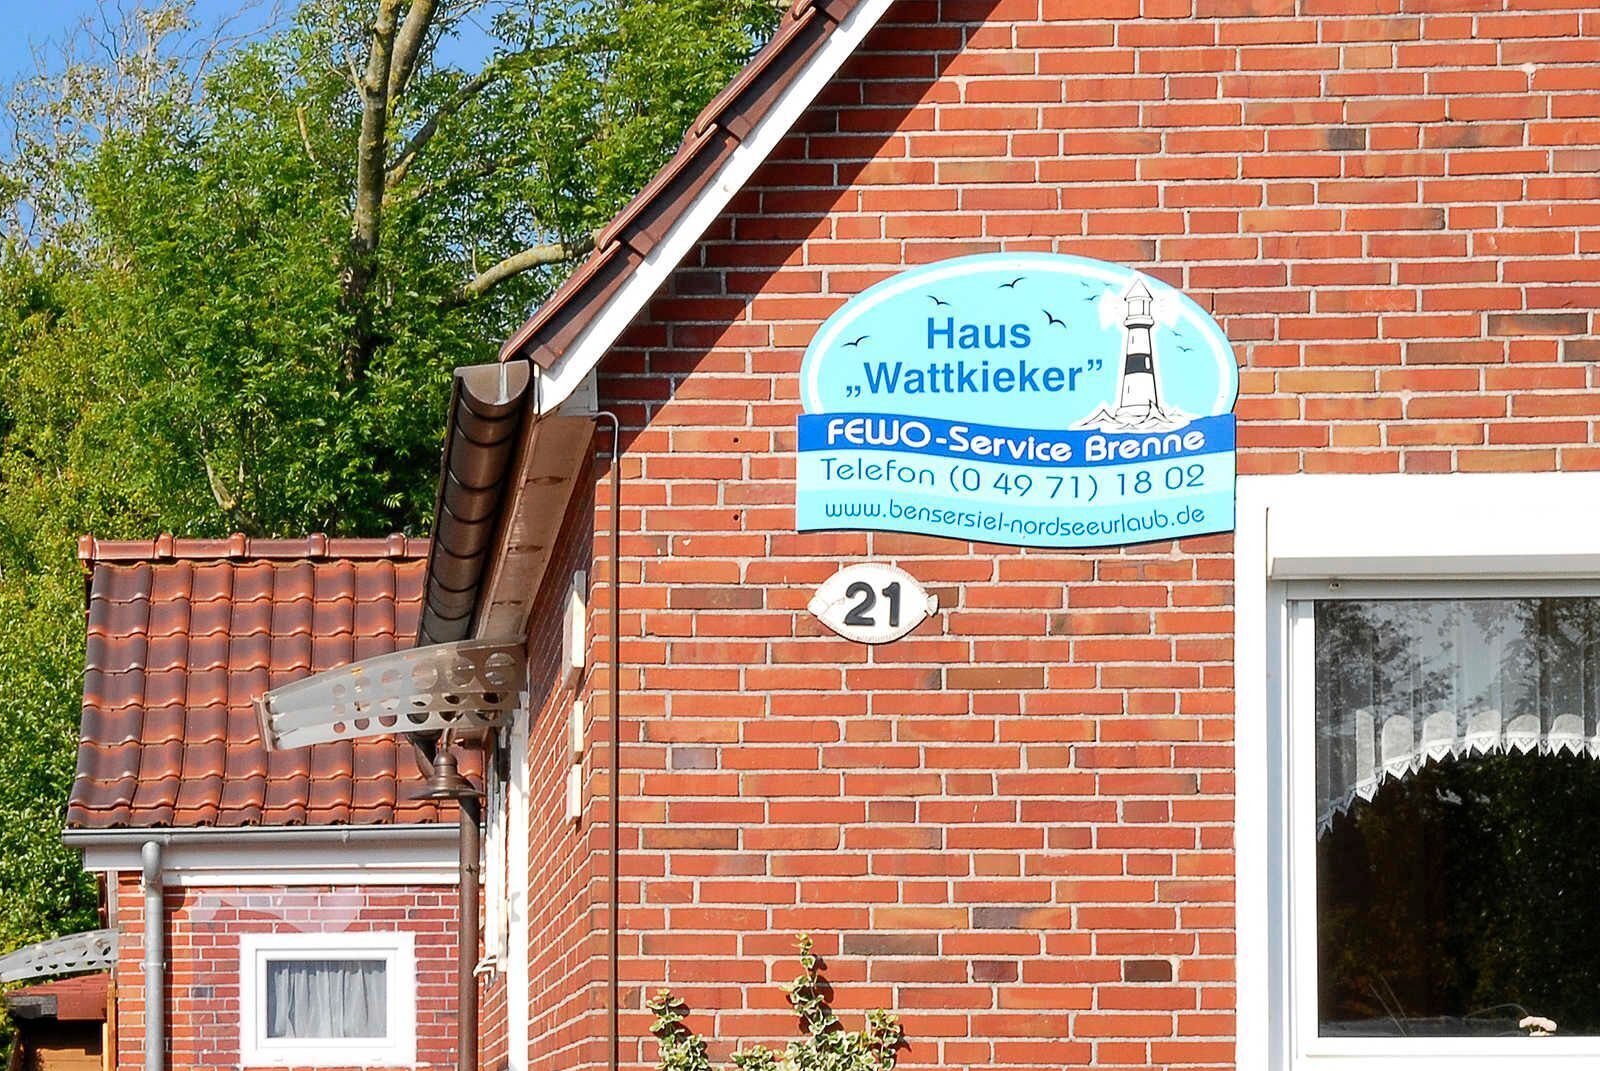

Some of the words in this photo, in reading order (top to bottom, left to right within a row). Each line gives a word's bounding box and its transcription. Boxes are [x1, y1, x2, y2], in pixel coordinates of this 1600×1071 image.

[927, 316, 1031, 349] Haus
[827, 418, 1073, 462] FEWO-Service
[1085, 430, 1206, 463] Brenne
[820, 457, 935, 486] Telefon
[950, 465, 981, 492] (0
[993, 472, 1033, 497] 49
[1046, 474, 1099, 502] 71)
[1117, 470, 1153, 496] 18
[1165, 463, 1206, 490] 02
[825, 498, 1206, 537] www.bensersiel-nordseeurlaub.de
[844, 581, 900, 627] 21
